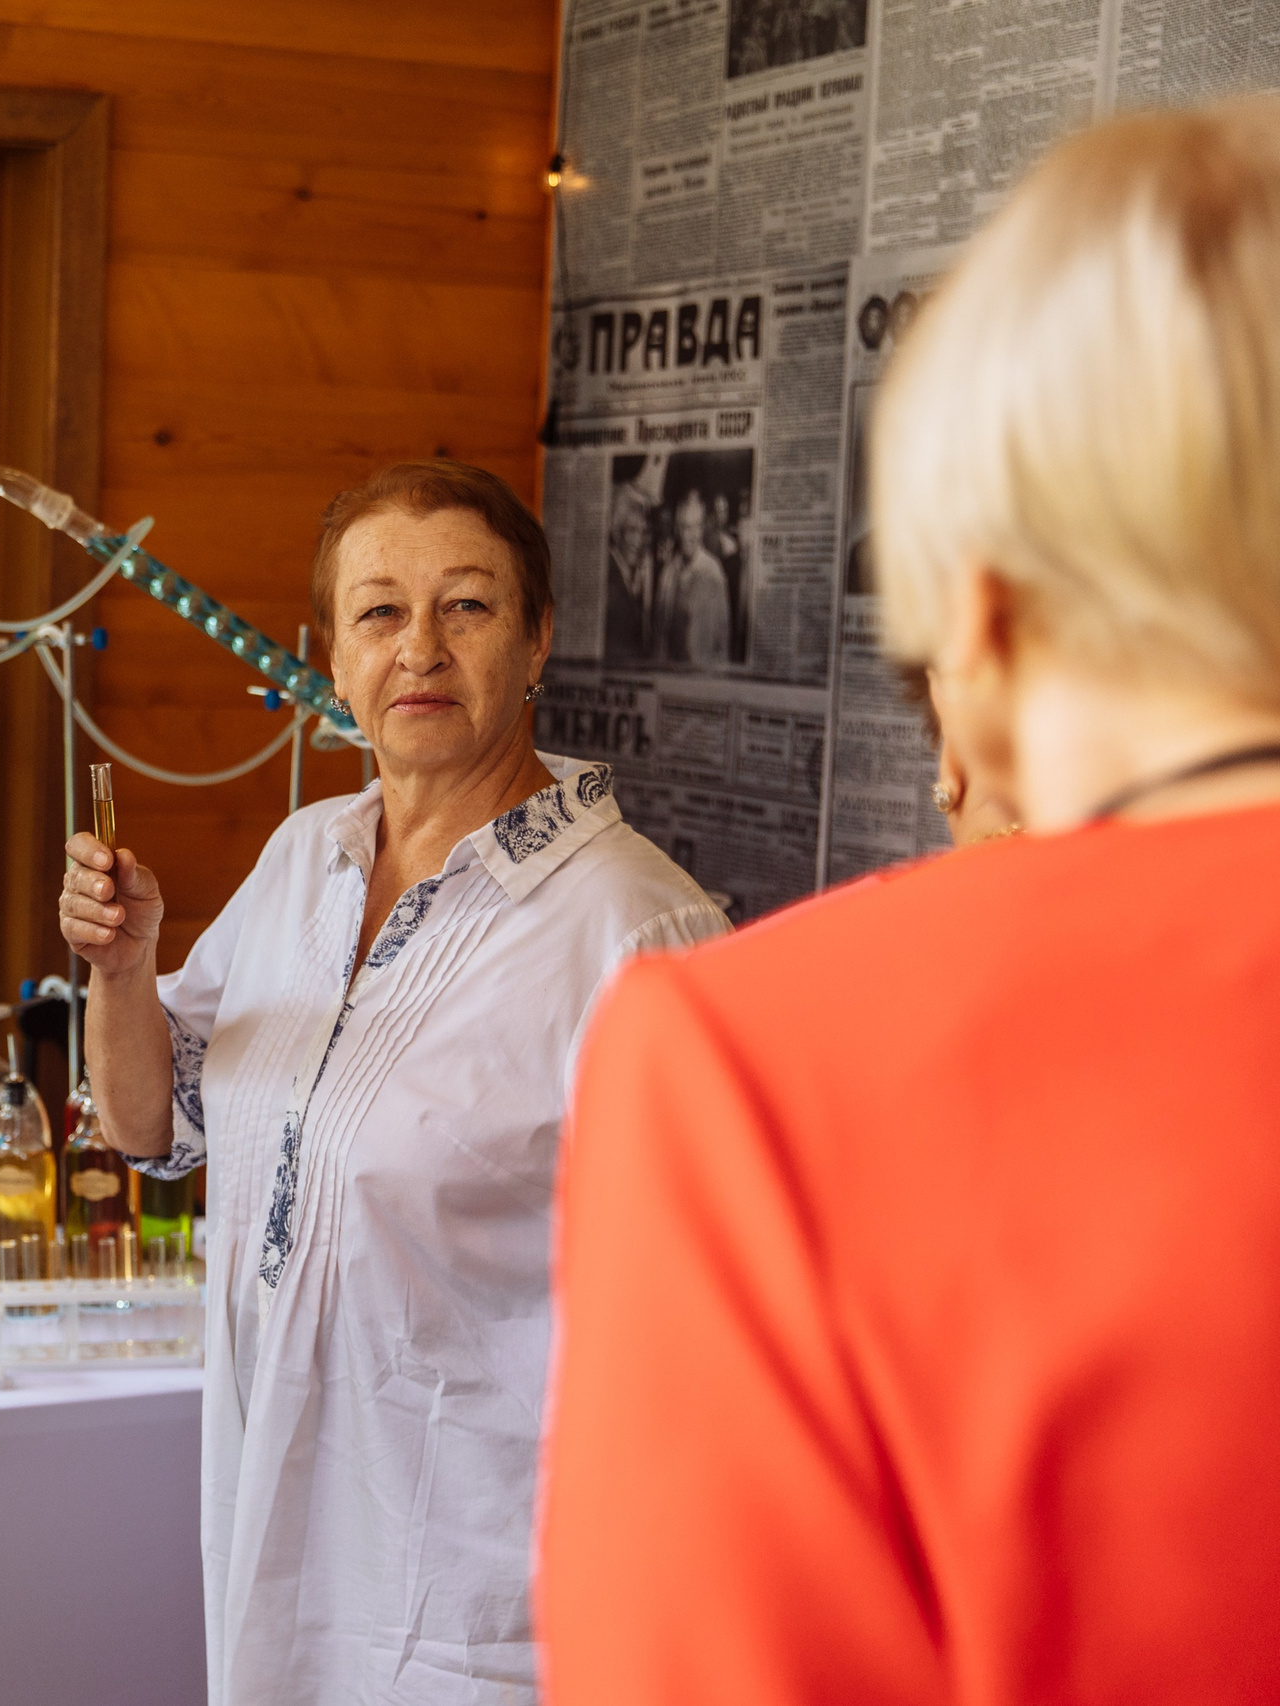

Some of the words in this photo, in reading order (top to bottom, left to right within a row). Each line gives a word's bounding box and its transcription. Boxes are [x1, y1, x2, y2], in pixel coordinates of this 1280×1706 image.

[589, 296, 761, 375] ПРАВДА
[637, 416, 709, 444] Президента
[716, 410, 754, 440] СССР
